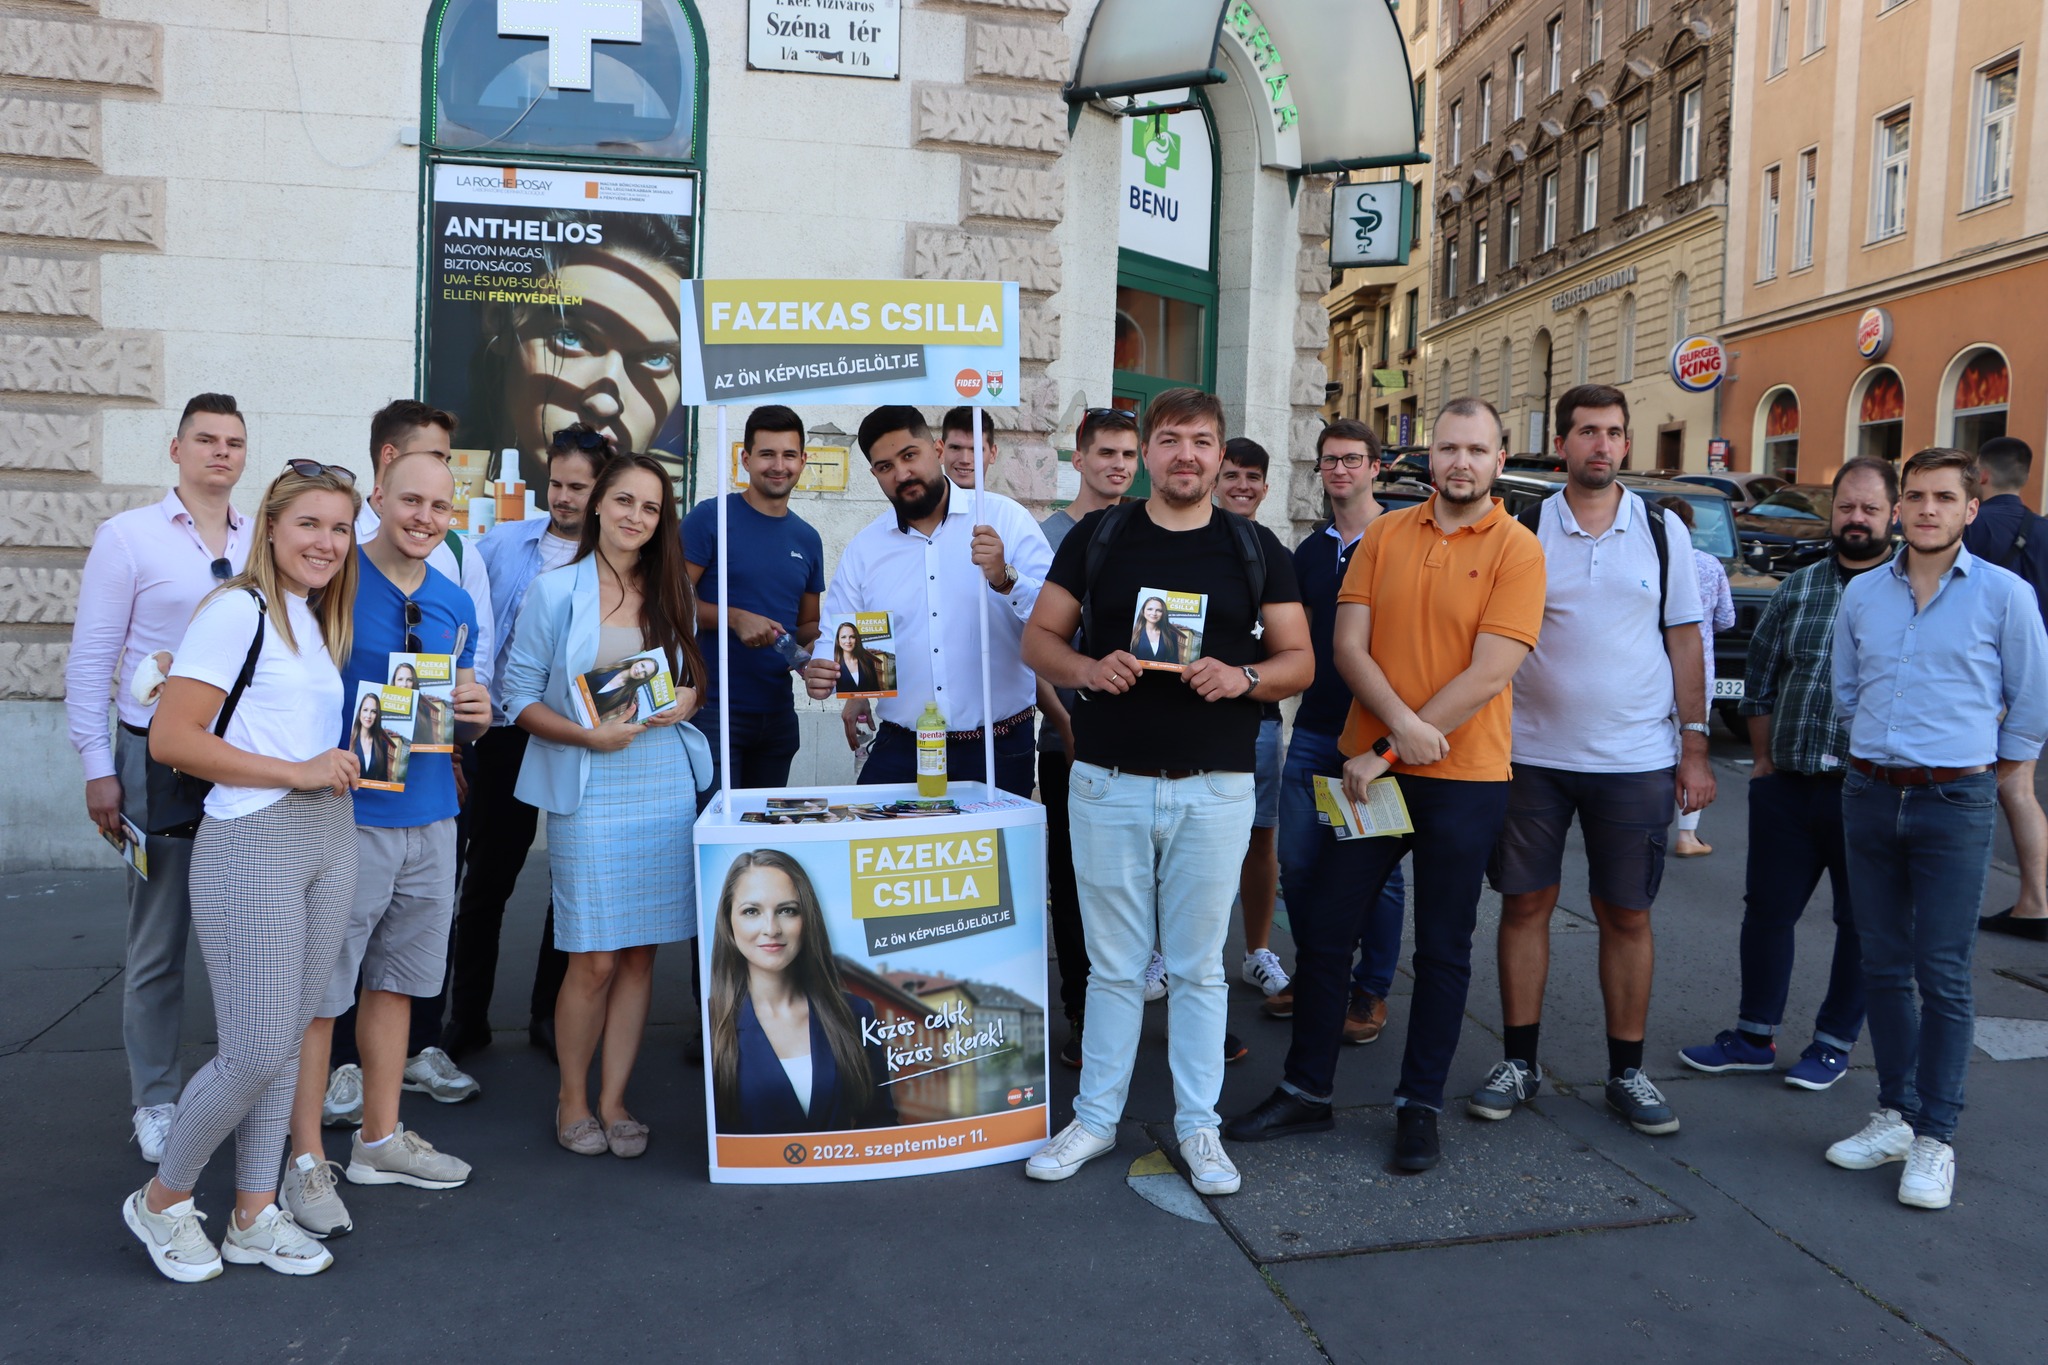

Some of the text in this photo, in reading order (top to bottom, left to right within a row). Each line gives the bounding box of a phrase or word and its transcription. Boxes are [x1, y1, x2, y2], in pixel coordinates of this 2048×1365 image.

[767, 12, 881, 43] Széna tér
[781, 46, 798, 60] 1/a
[851, 51, 870, 66] 1/b
[457, 176, 553, 190] LA ROCHE POSAY
[1130, 185, 1179, 222] BENU
[444, 216, 603, 245] ANTHELIOS
[445, 243, 545, 259] NAGYON MAGAS,
[444, 258, 532, 274] BIZTONSÁGOS
[444, 274, 471, 285] UVA-
[474, 272, 490, 286] ÉS
[444, 289, 583, 306] ELLENI FÉNYVÉDELEM
[711, 301, 999, 332] FAZEKAS CSILLA
[1858, 323, 1880, 347] KING
[1679, 346, 1720, 366] BURGER
[714, 352, 920, 389] AZ ÖN KÉPVISELŐJELÖLTJE
[1680, 356, 1722, 381] KING
[956, 379, 982, 387] FIDESZ
[1167, 597, 1199, 605] FAZEKAS
[416, 660, 448, 669] FAZEKAS
[420, 669, 444, 677] CSILLA
[1715, 681, 1743, 695] 832
[381, 692, 411, 703] FAZEKAS
[383, 701, 406, 711] CSILLA
[856, 837, 993, 873] FAZEKAS
[873, 874, 980, 908] CSILLA
[874, 910, 1011, 949] AZ ÖN KÉPVISELŐJELÖLTJE
[860, 1000, 973, 1047] Közös célok,
[886, 1018, 1004, 1073] közös sikerek!
[813, 1128, 988, 1160] 2022. szeptember 11.
